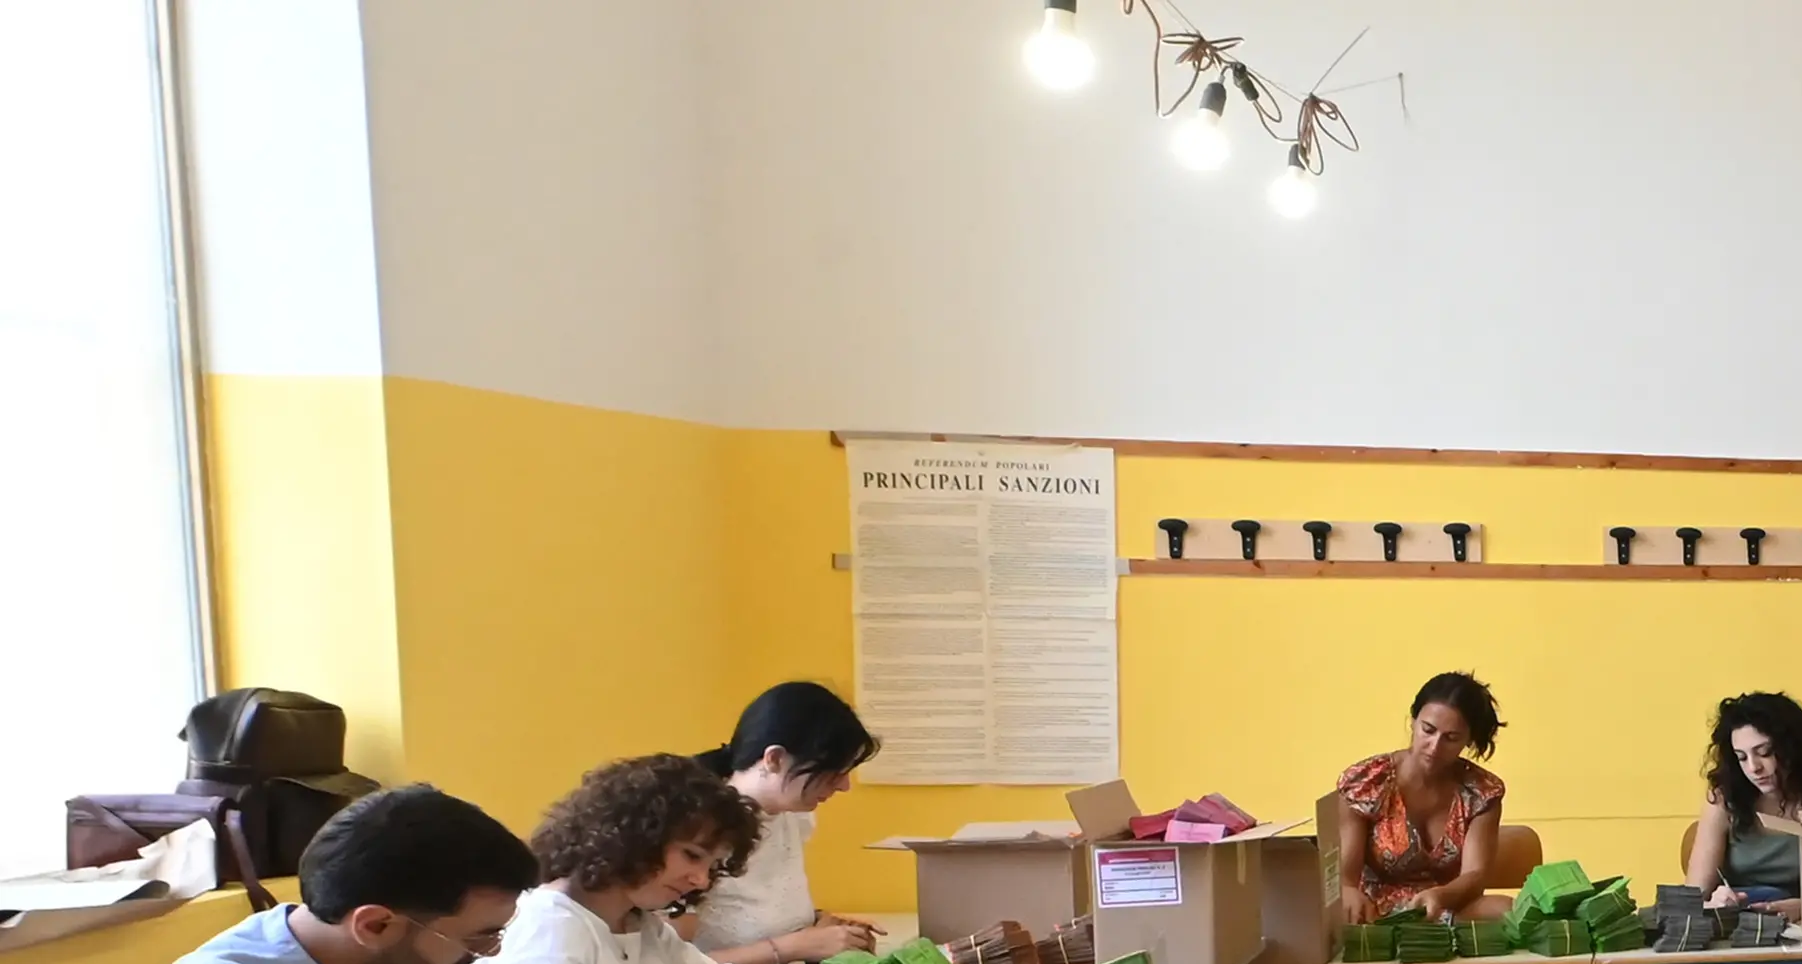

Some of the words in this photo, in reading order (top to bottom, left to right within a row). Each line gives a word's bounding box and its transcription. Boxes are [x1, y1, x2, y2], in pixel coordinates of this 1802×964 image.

[914, 459, 989, 469] REFERENDUM
[996, 461, 1050, 471] POPOLARI
[863, 472, 984, 491] PRINCIPALI
[999, 476, 1101, 495] SANZIONI
